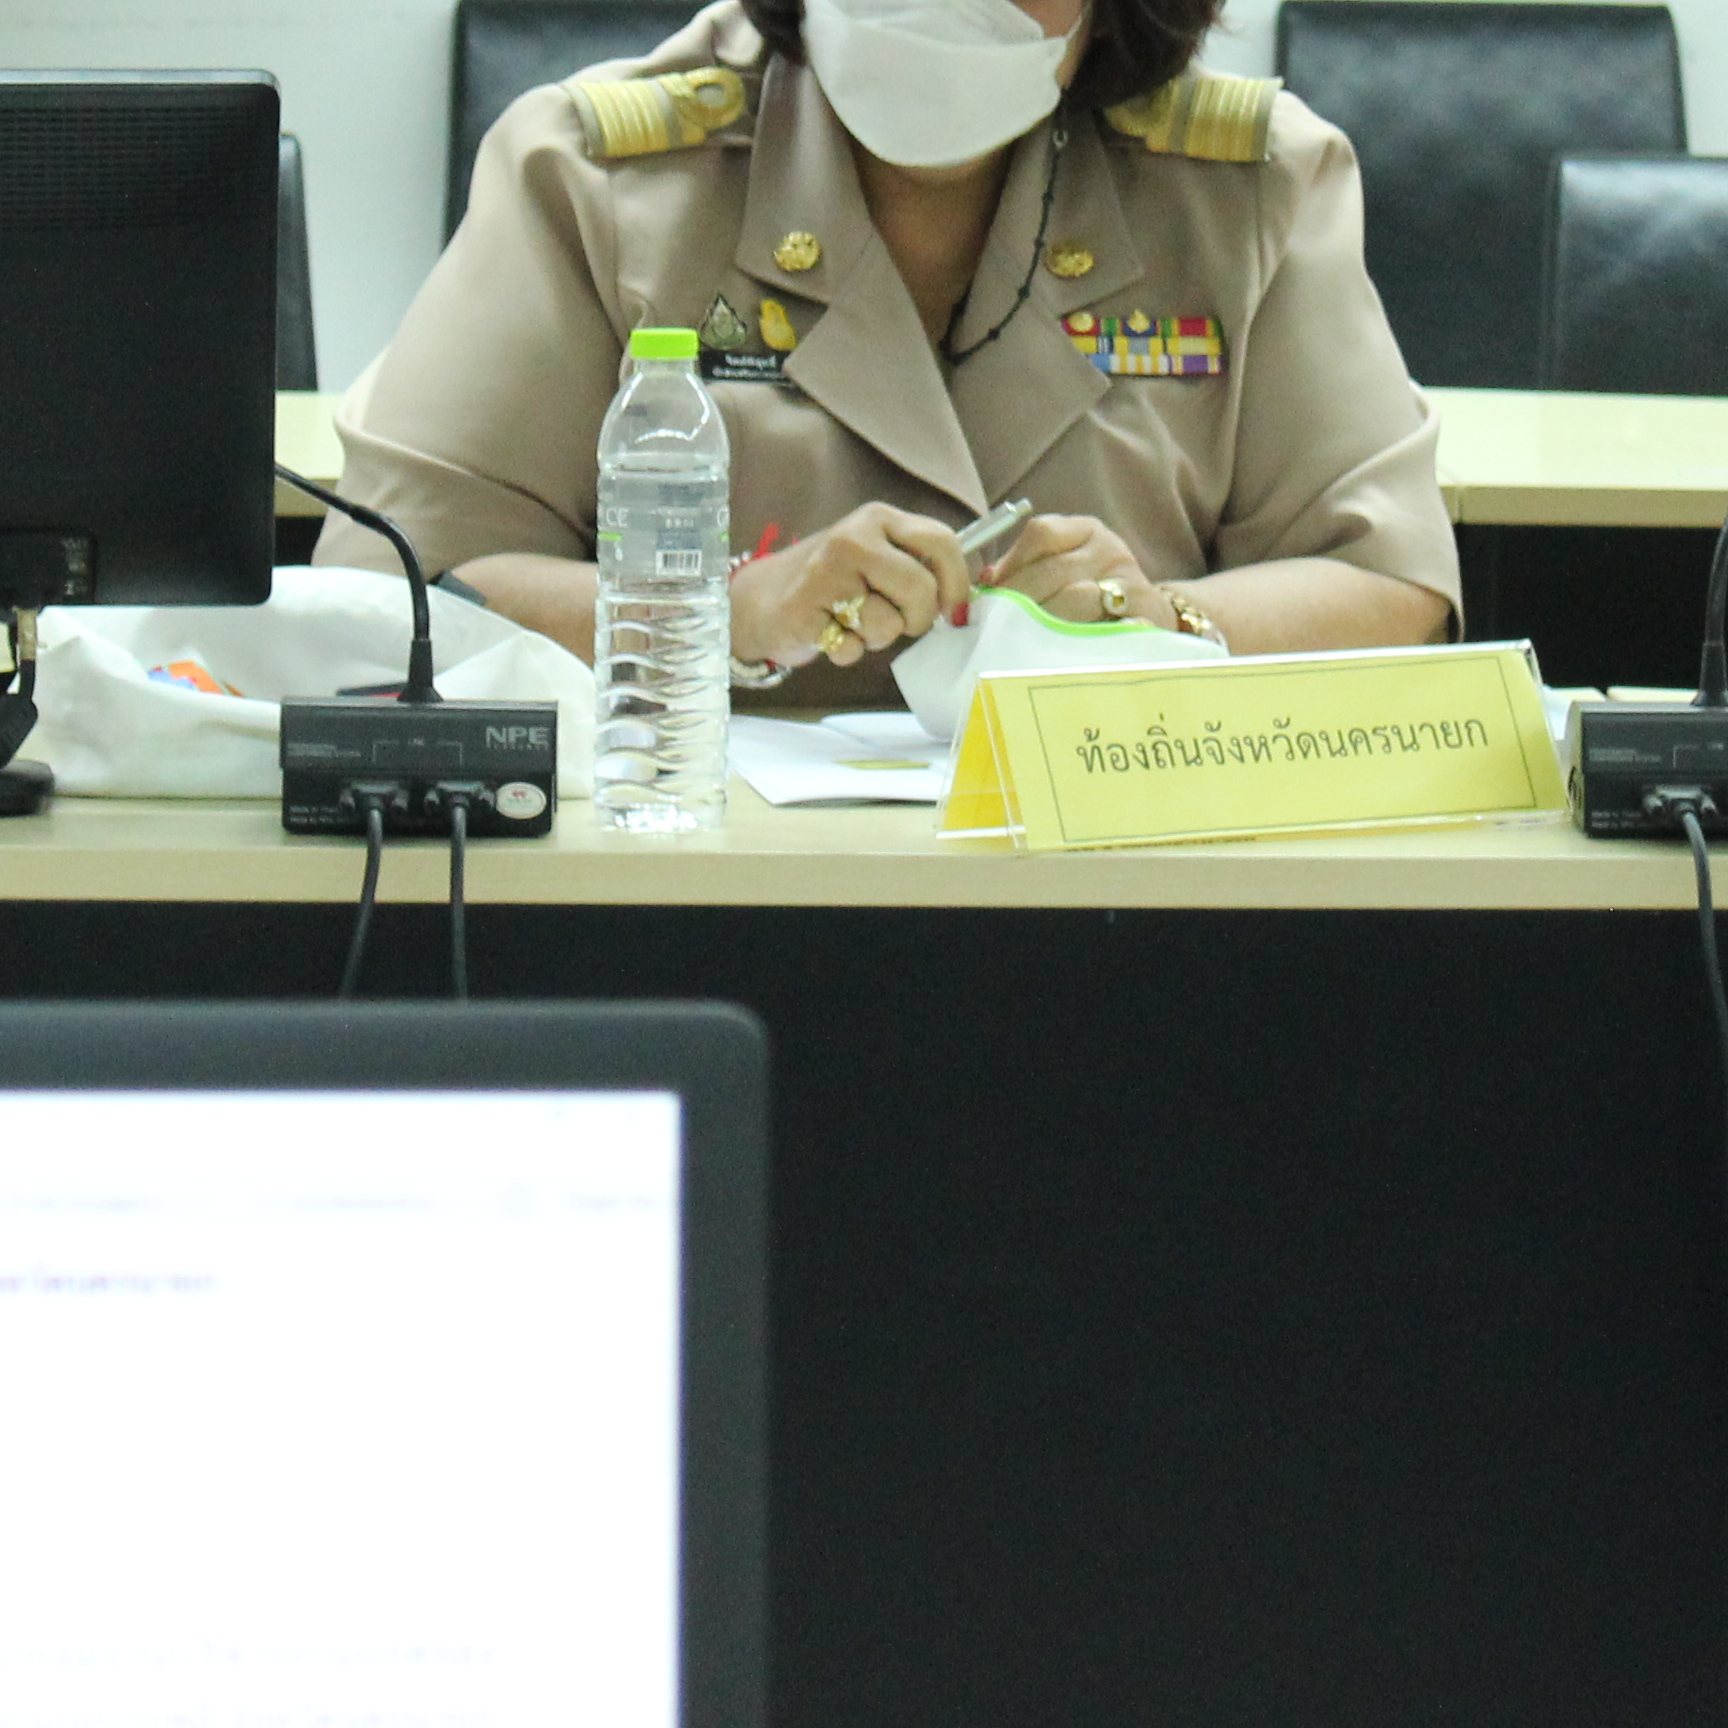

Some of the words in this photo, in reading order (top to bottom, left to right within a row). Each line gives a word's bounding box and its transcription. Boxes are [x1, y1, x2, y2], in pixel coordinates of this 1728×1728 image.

[485, 726, 551, 745] NPE
[1076, 712, 1489, 774] ท้องถิ่นจังหวัดนครนายก
